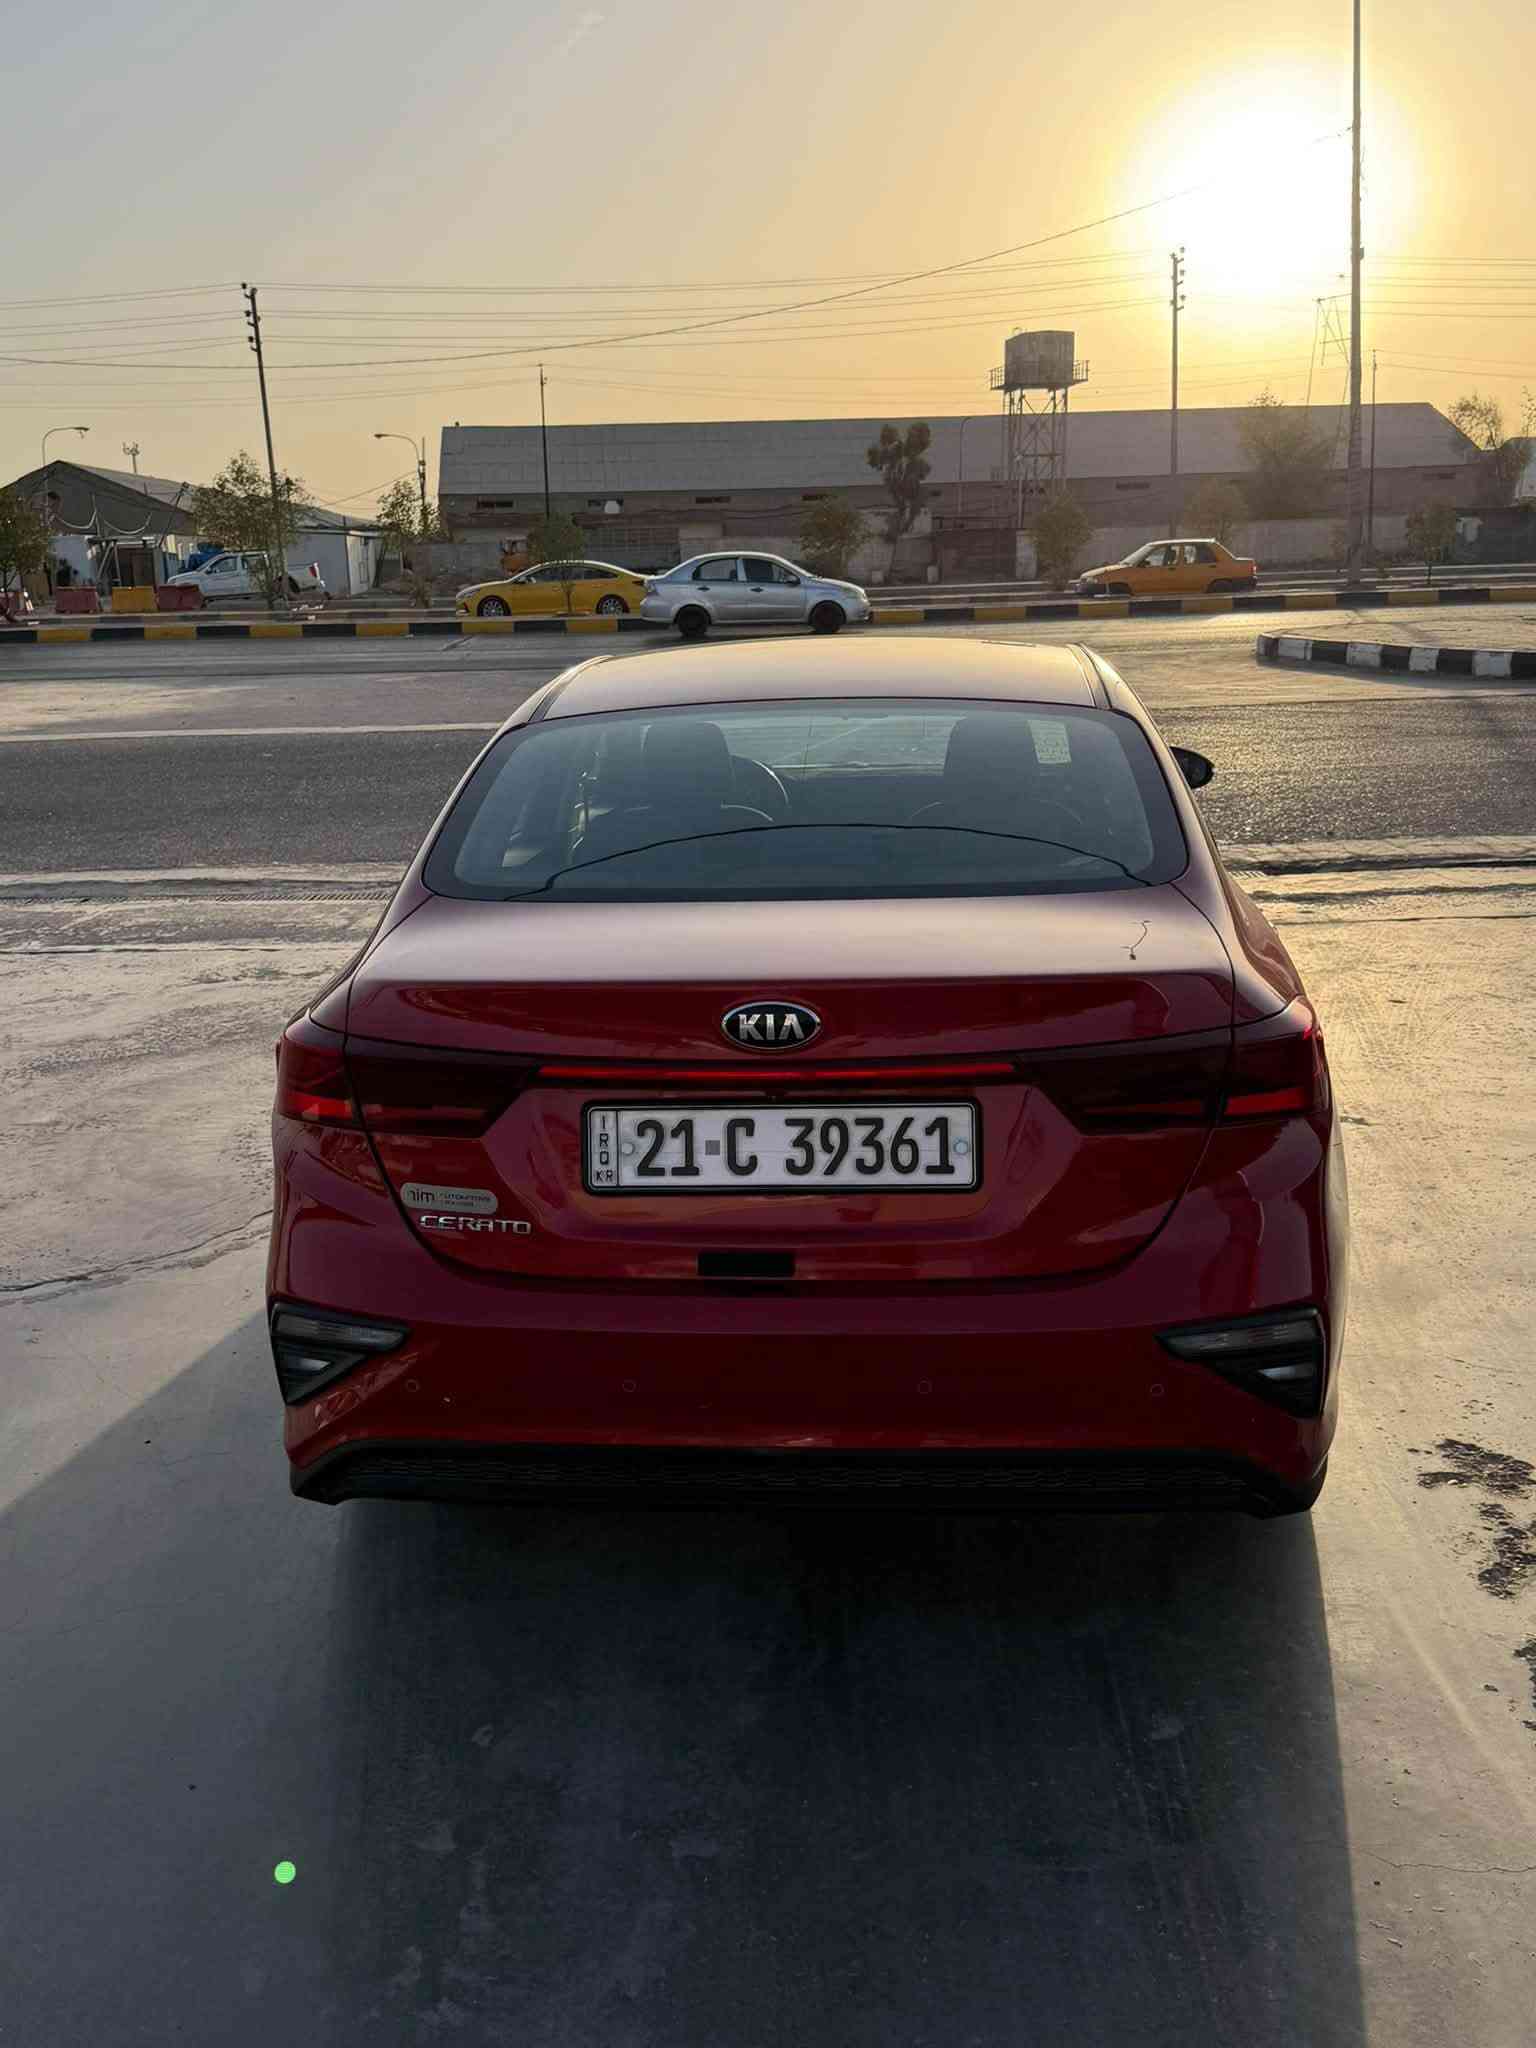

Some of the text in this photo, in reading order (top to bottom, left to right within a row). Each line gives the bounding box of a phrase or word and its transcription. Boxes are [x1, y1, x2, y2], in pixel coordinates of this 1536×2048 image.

[738, 1013, 804, 1041] KIA
[636, 1116, 955, 1177] 21 C 39361
[420, 1215, 532, 1234] CERATO
